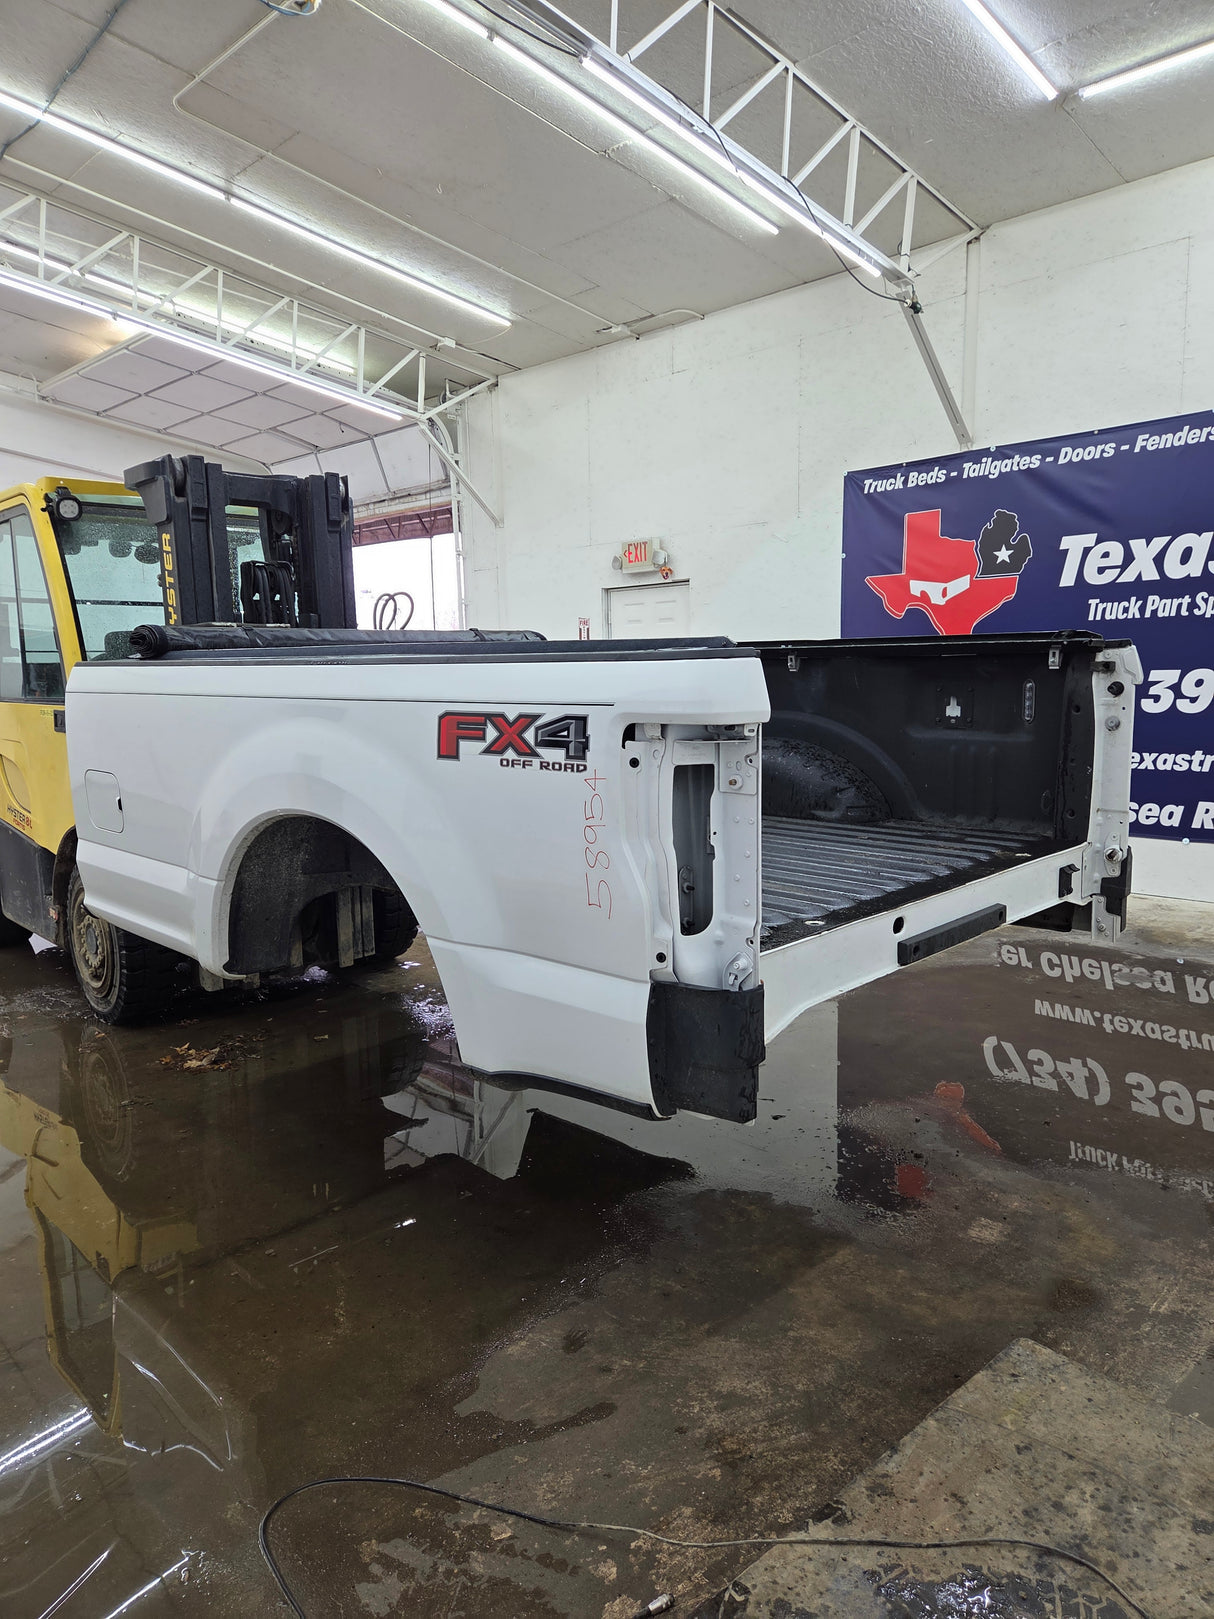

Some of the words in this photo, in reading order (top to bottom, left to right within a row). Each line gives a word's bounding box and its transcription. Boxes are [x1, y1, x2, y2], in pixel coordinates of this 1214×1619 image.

[863, 473, 906, 494] Truck
[907, 466, 947, 488] Beds
[962, 454, 1042, 479] Tailgates
[1057, 442, 1116, 465] Doors
[627, 541, 648, 563] EXIT
[1058, 531, 1214, 588] Texa
[1088, 596, 1143, 621] Truck
[1144, 595, 1191, 618] Part
[1140, 668, 1214, 714] 39
[436, 710, 591, 762] FX4
[499, 757, 533, 769] OFF
[539, 760, 588, 773] ROAD
[583, 768, 613, 920] 58954
